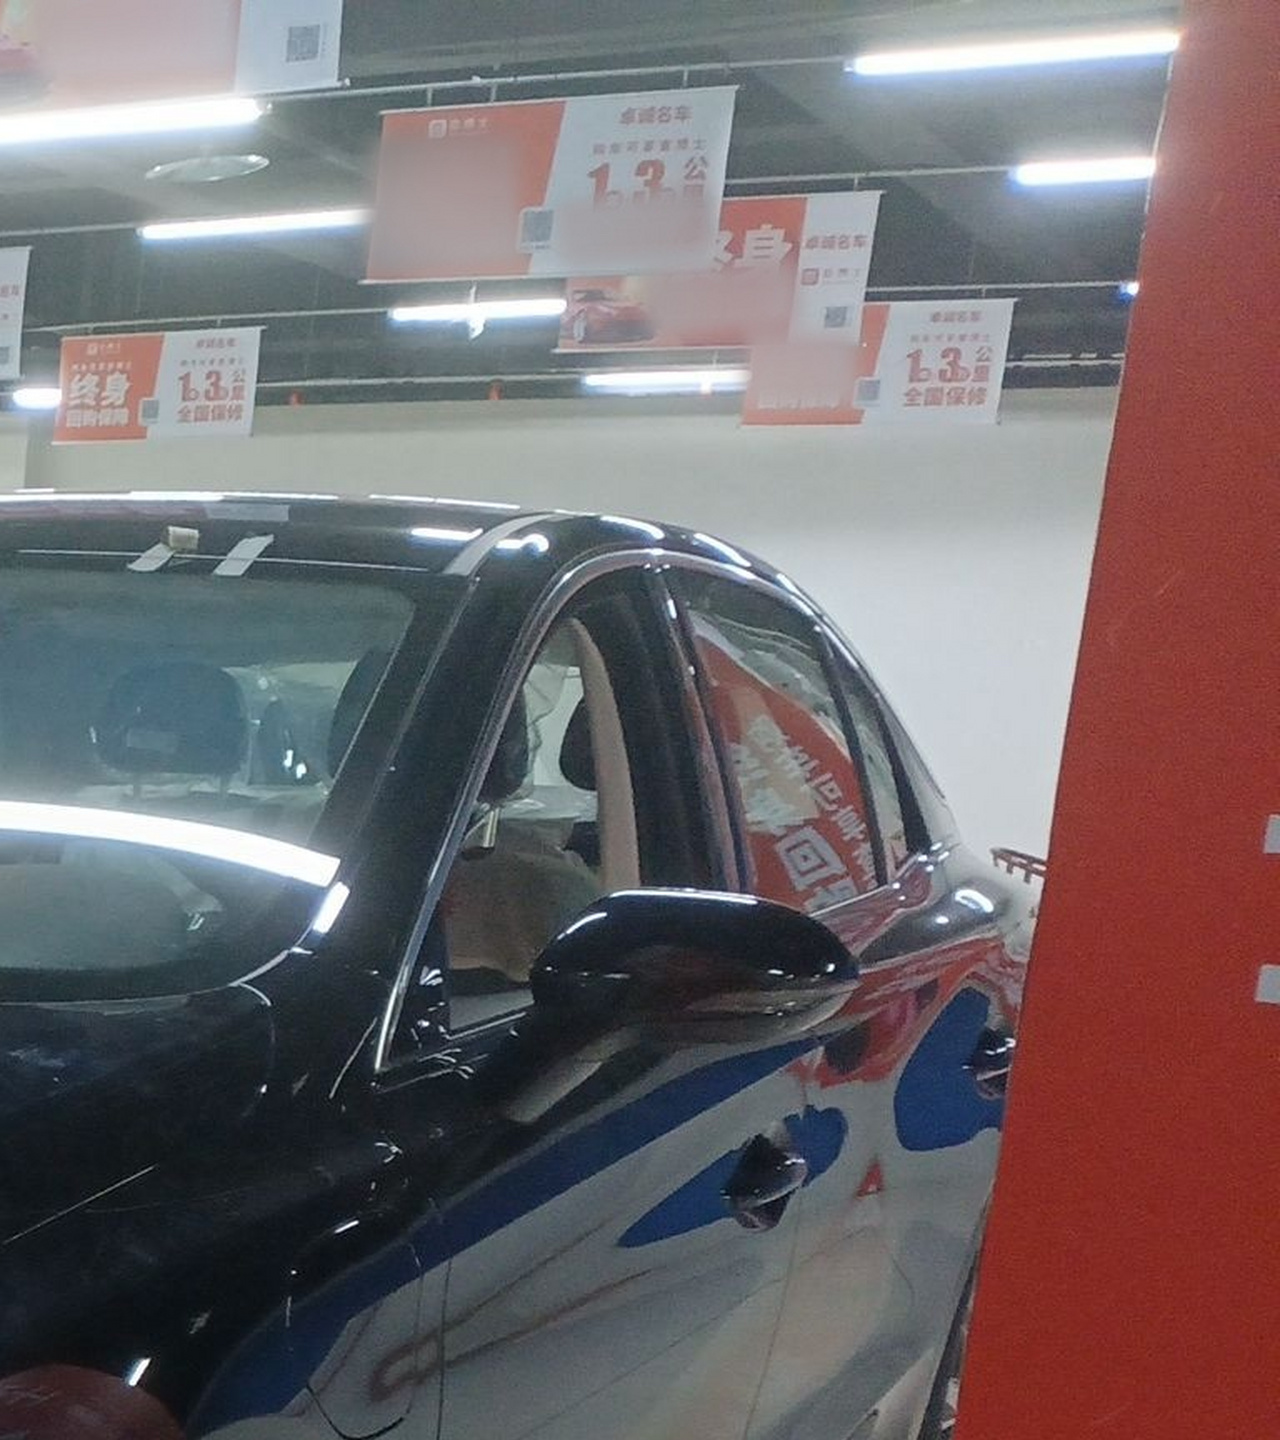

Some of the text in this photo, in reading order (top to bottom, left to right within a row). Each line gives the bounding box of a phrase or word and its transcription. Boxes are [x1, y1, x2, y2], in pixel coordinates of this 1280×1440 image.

[68, 371, 131, 408] 终身
[902, 386, 988, 407] 全国保修
